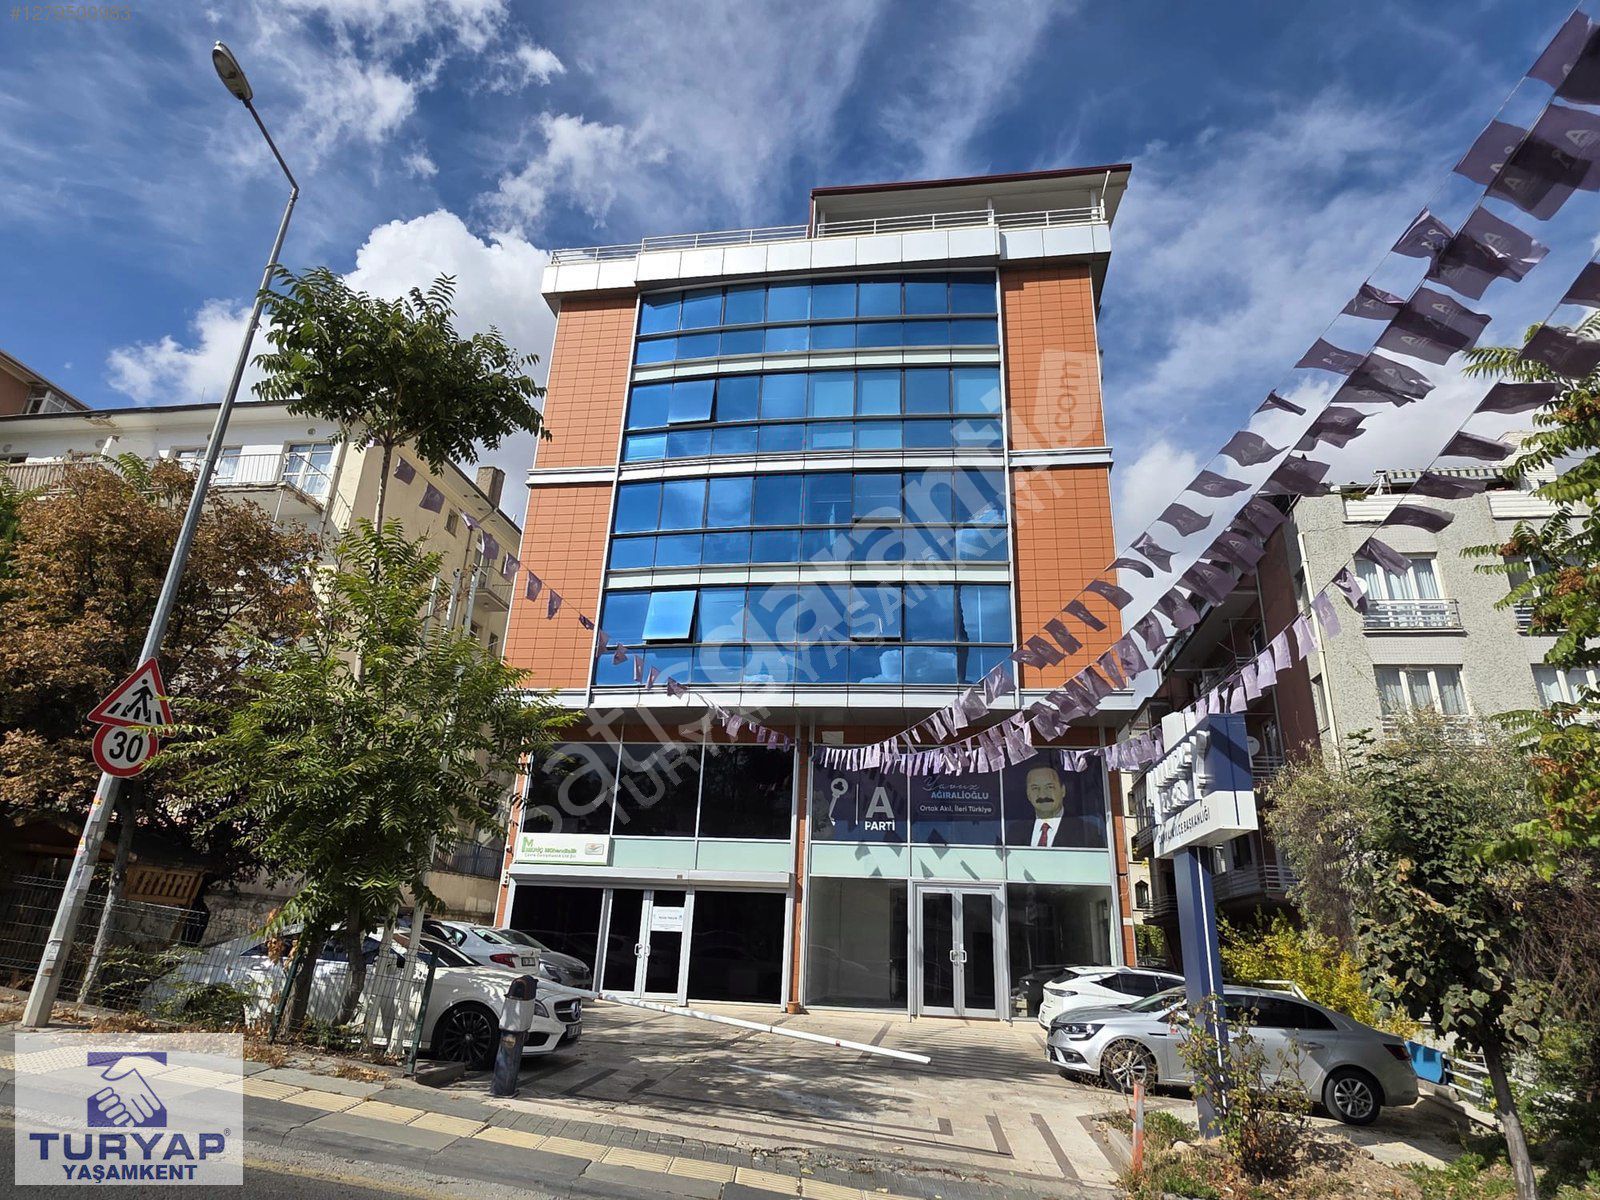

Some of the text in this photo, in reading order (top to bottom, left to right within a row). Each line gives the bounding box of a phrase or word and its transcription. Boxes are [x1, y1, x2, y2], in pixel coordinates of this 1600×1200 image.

[109, 731, 143, 763] 30
[931, 790, 989, 800] AĞIRALİOĞLU
[865, 786, 895, 818] A
[919, 804, 938, 812] Ortak
[968, 805, 993, 813] Türkiye
[864, 819, 896, 831] PARTİ
